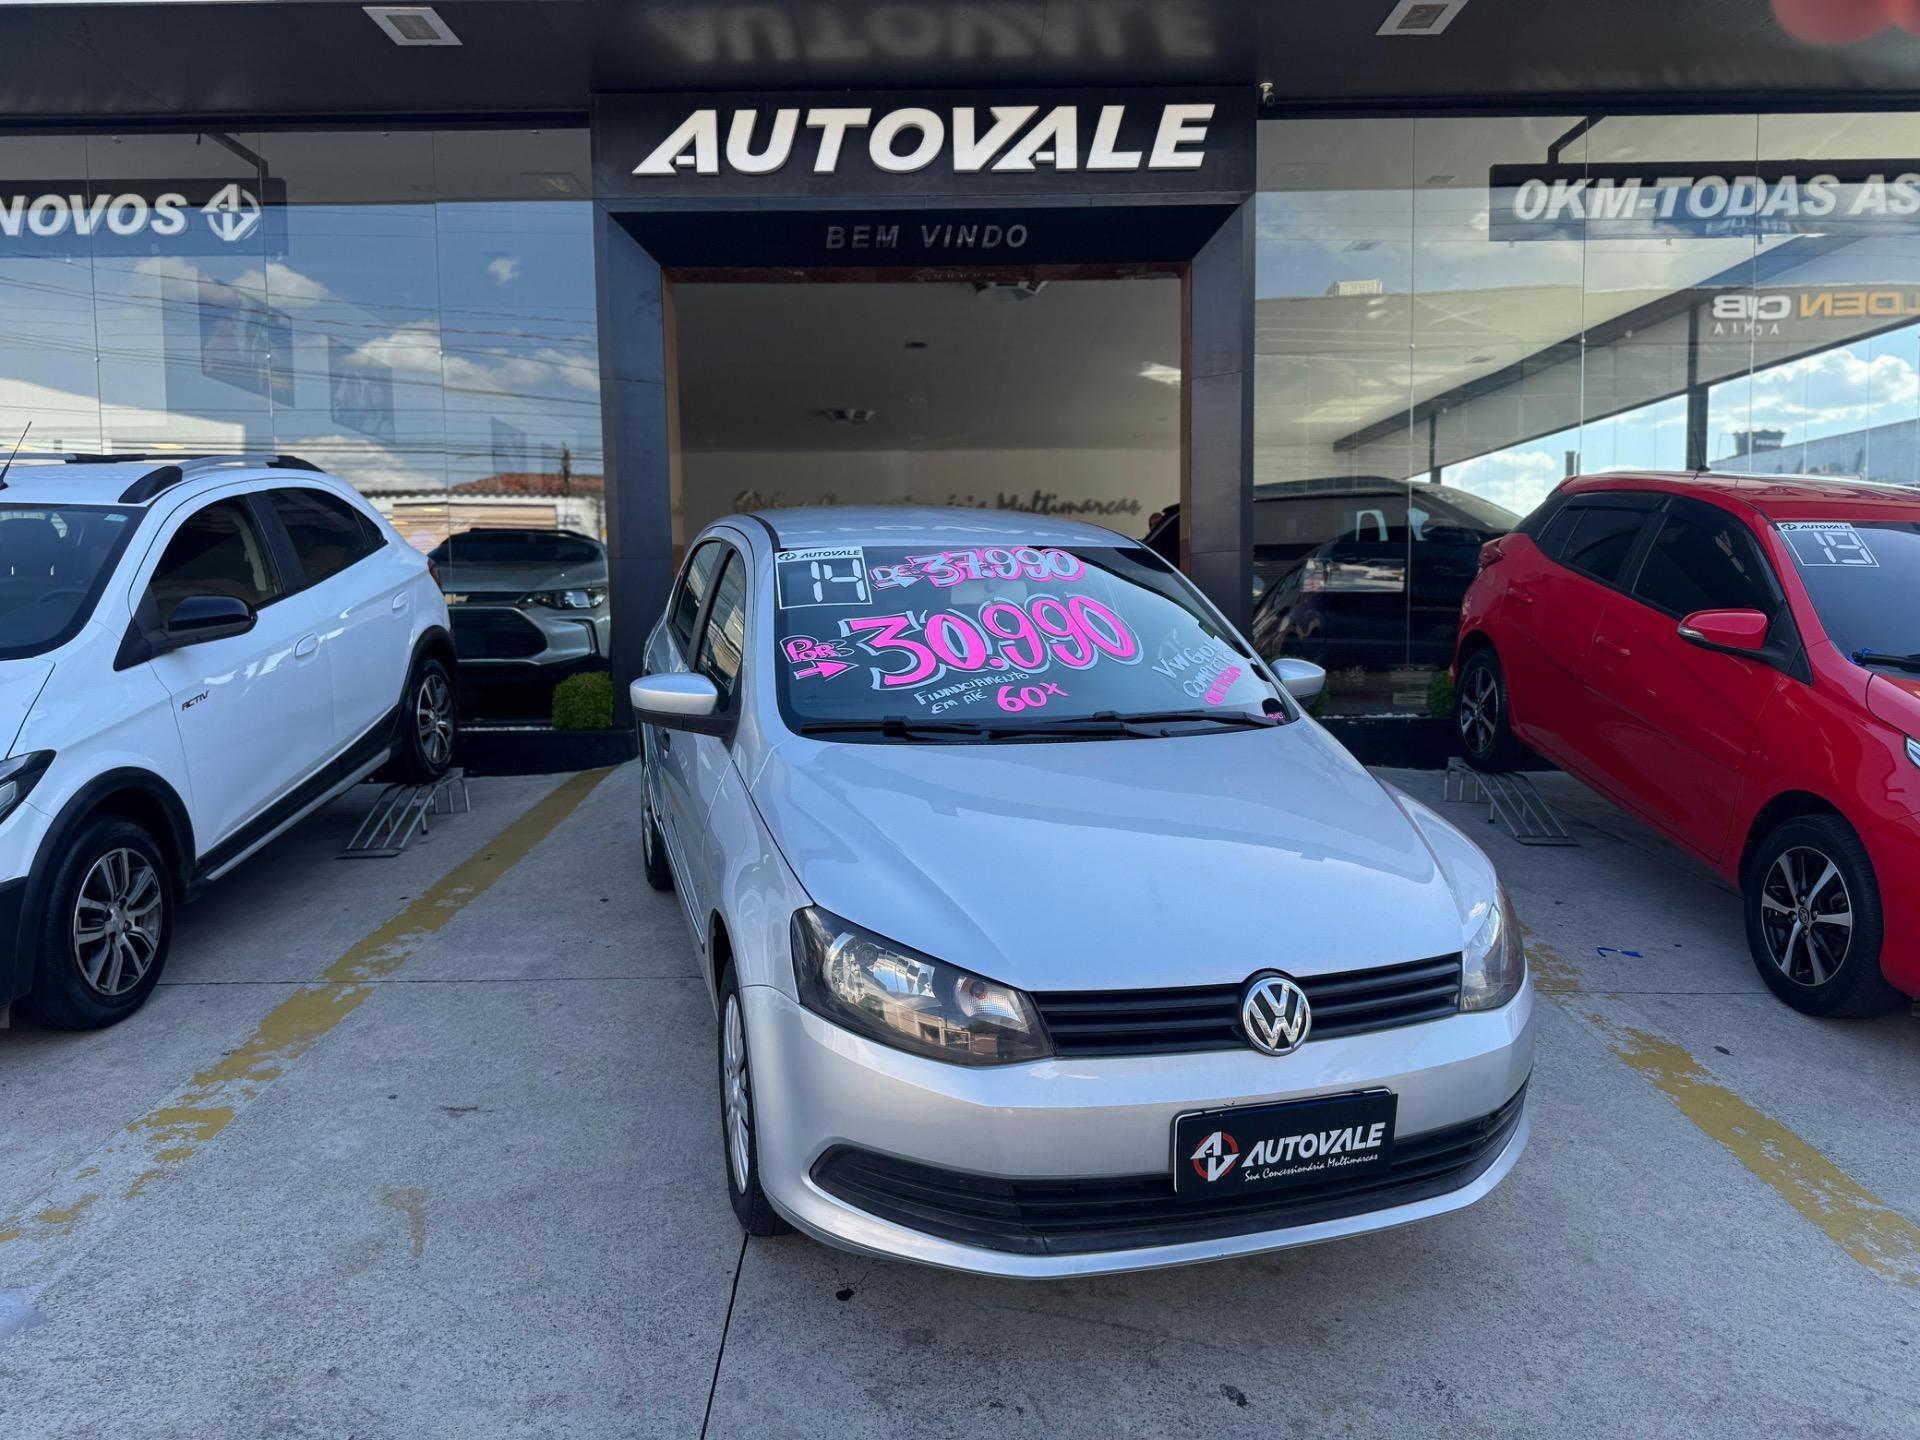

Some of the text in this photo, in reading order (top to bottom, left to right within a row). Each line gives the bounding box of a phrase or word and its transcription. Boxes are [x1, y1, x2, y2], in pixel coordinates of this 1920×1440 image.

[632, 104, 1215, 176] AUTOVALE
[0, 193, 188, 237] NOVOS
[1846, 173, 1920, 216] AS
[827, 224, 1028, 249] BEM VINDO
[801, 550, 861, 559] AUTOVALE
[905, 547, 1086, 587] 37.990
[1813, 532, 1873, 564] 19
[811, 559, 866, 602] 14
[840, 592, 1143, 690] 30.990
[182, 690, 209, 711] ACTIV
[1241, 1122, 1386, 1168] AUTOVALE
[1244, 1153, 1378, 1182] Sua Concessionária Multimarcas
